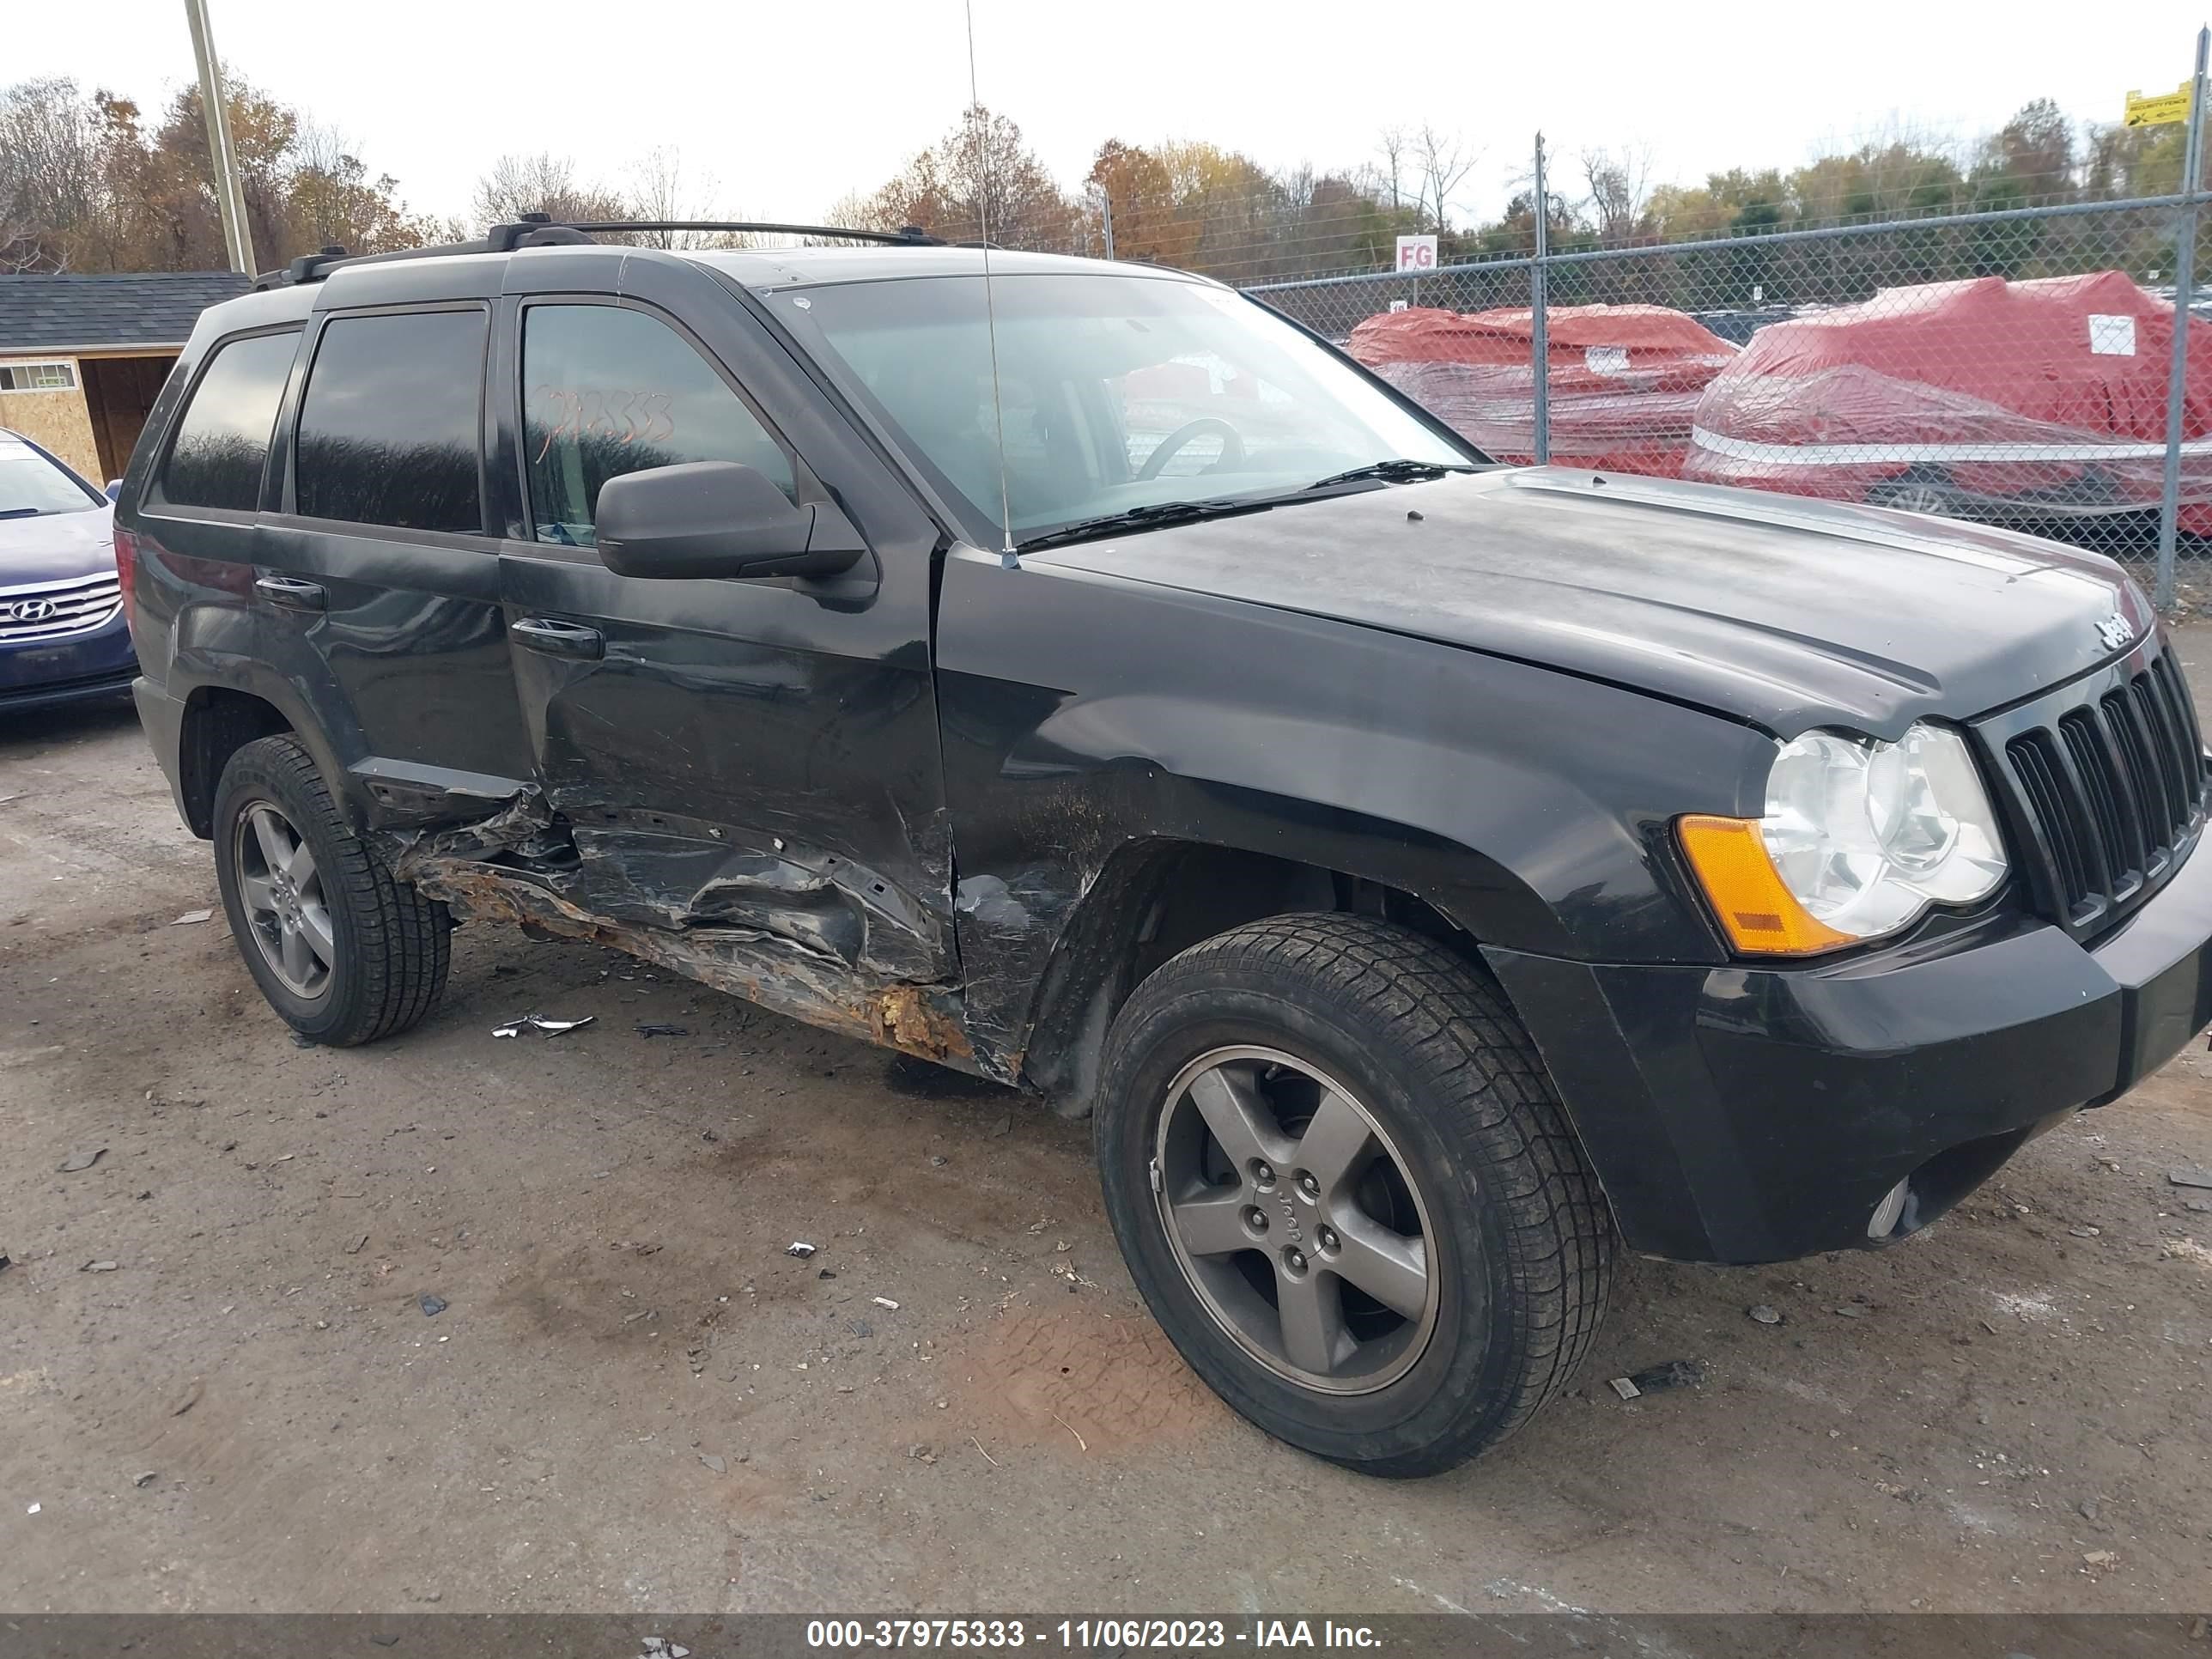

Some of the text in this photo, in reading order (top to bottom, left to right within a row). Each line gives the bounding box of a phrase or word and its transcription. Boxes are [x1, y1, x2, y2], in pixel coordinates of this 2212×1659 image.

[1401, 245, 1431, 267] FG
[2095, 612, 2134, 648] Jeep
[1277, 1191, 1302, 1243] Jeep
